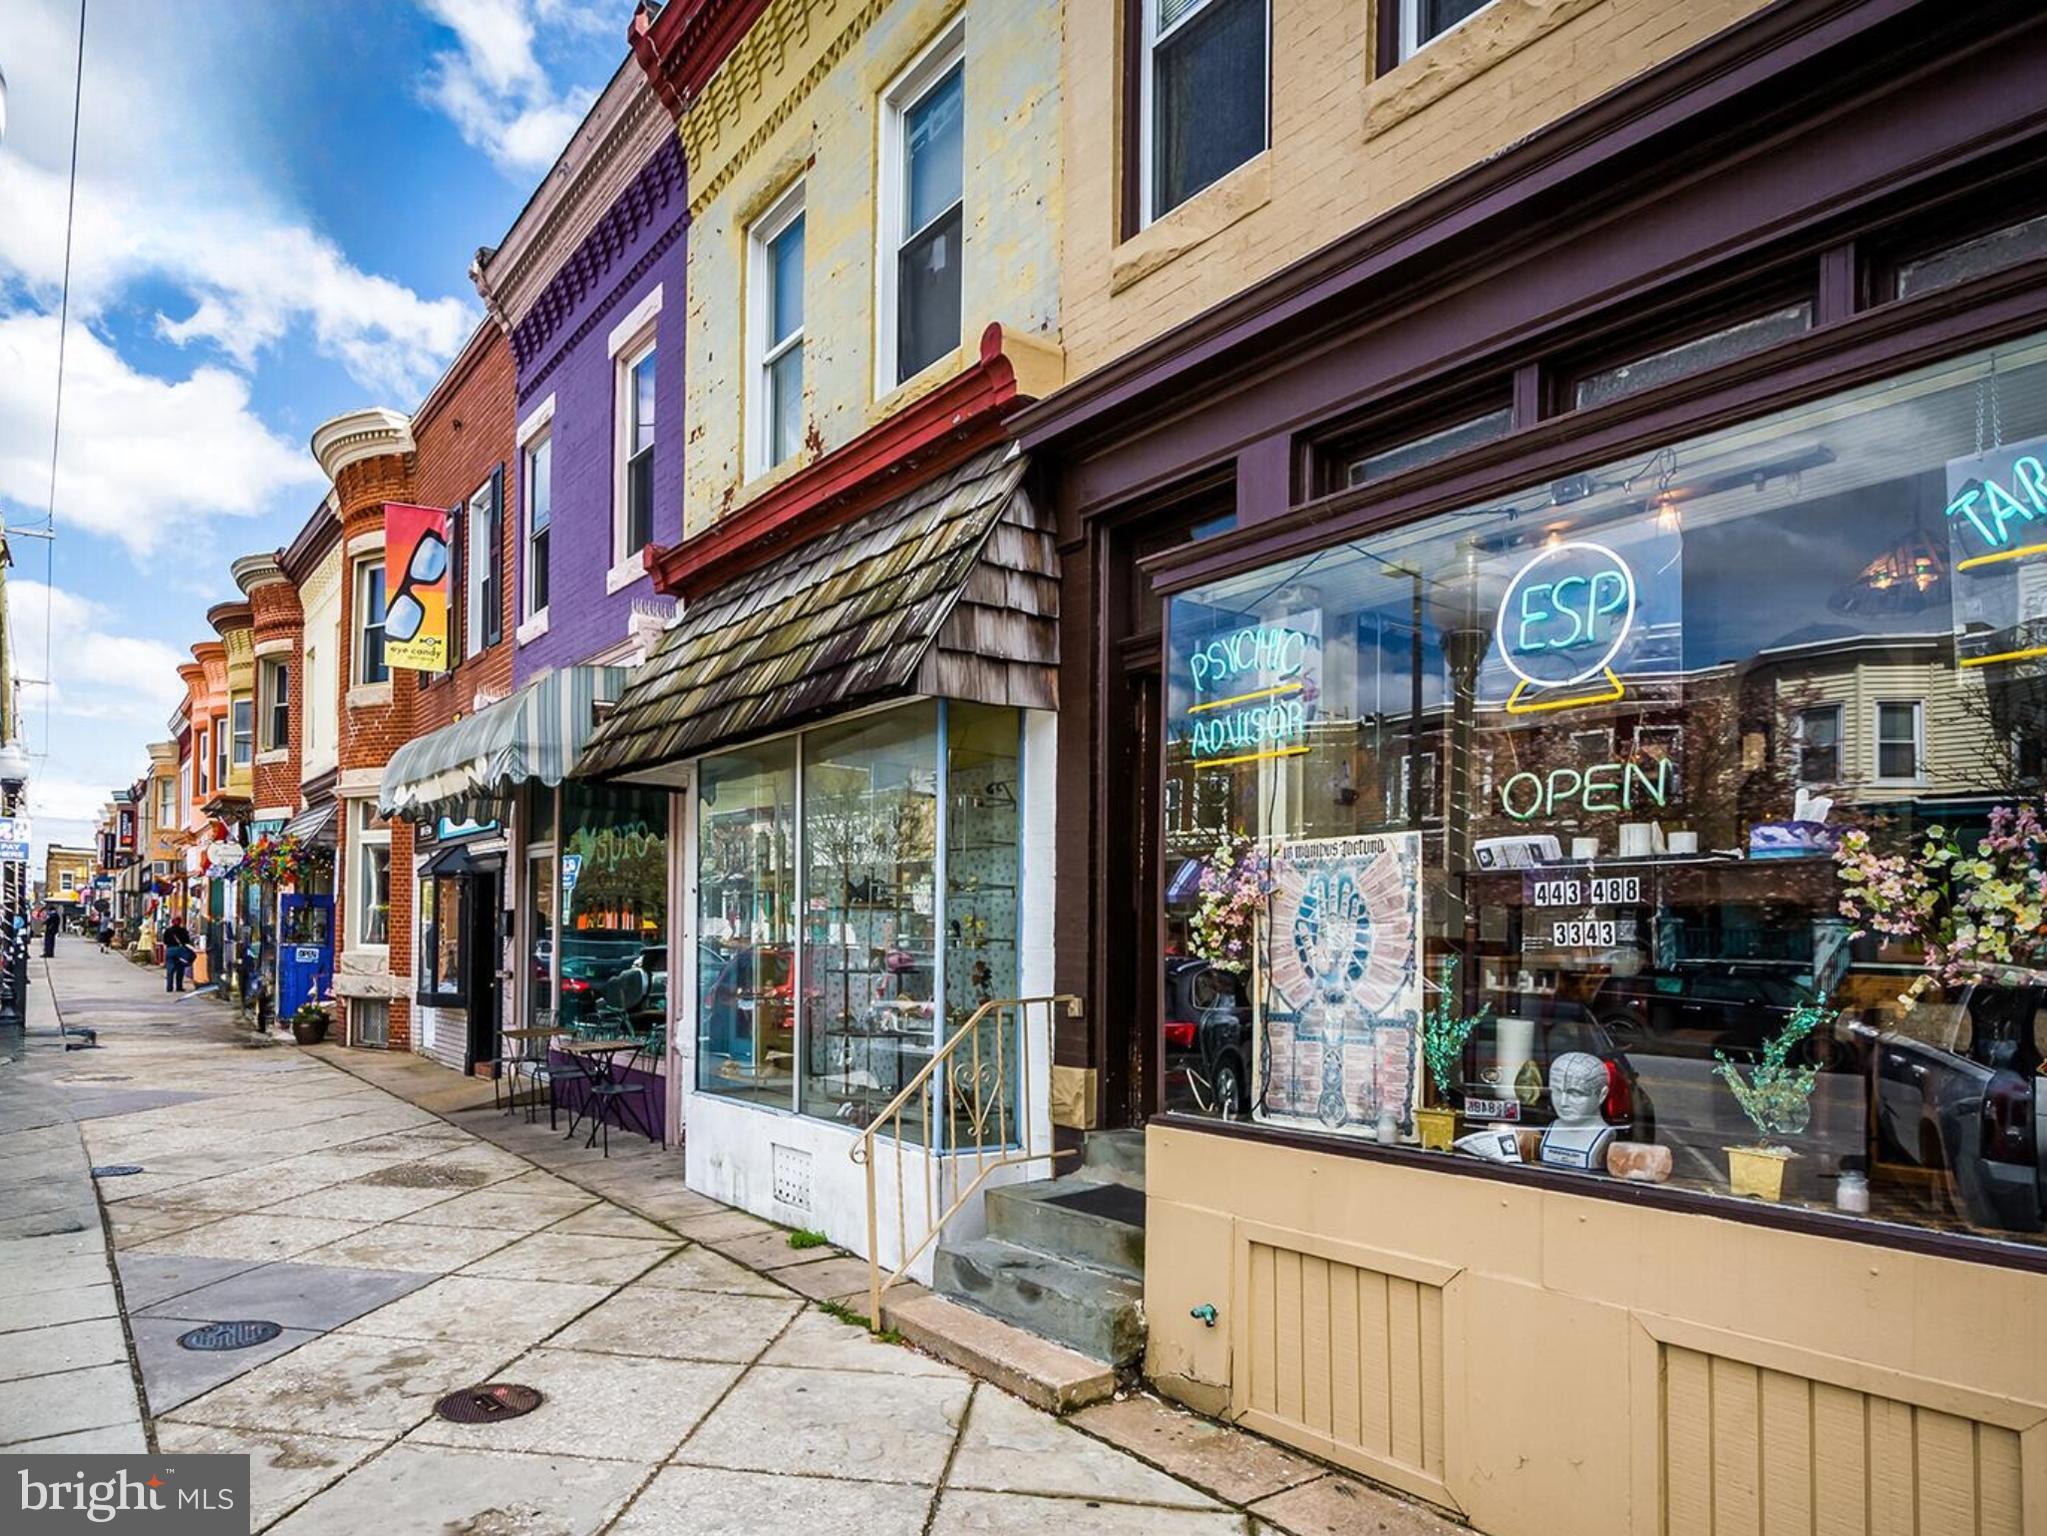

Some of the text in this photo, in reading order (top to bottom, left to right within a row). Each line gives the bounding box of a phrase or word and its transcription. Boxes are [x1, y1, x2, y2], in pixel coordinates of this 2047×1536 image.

[1946, 456, 2047, 546] TAR
[1519, 570, 1628, 651] ESP
[1190, 629, 1306, 692] PSYCHIC
[1191, 700, 1306, 758] ADVISOR
[1502, 758, 1667, 821] OPEN
[1536, 878, 1638, 905] 443 488
[1555, 921, 1614, 945] 3343
